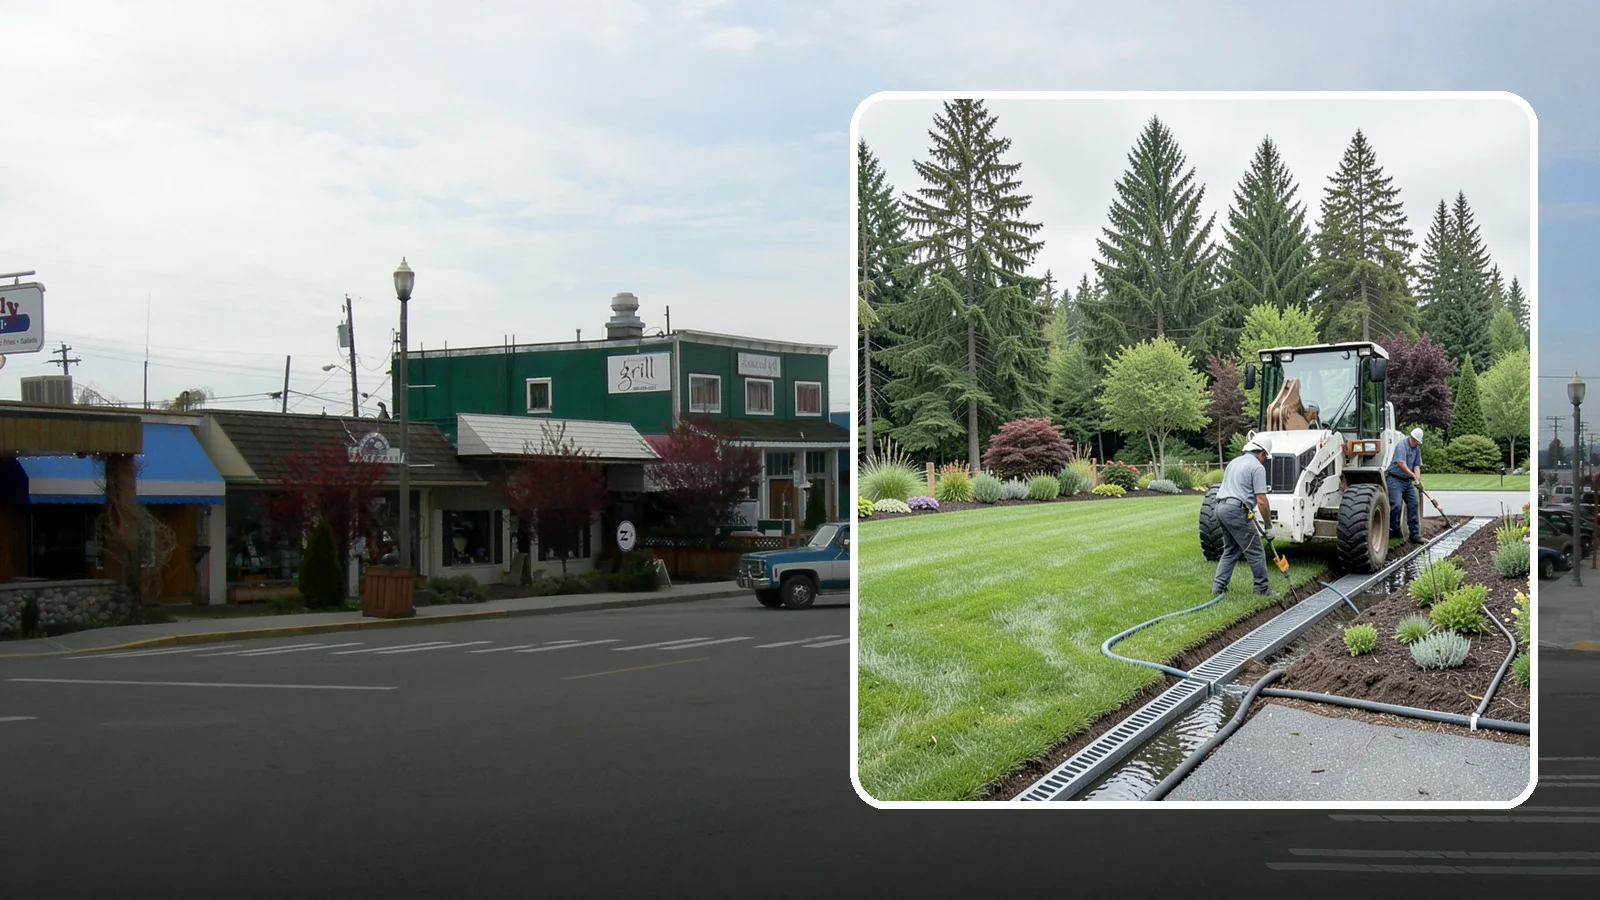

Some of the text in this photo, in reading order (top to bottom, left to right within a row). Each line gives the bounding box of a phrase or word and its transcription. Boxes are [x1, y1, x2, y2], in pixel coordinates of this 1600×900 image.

[3, 338, 16, 346] Fries
[20, 337, 38, 345] Salads
[617, 356, 654, 392] grill
